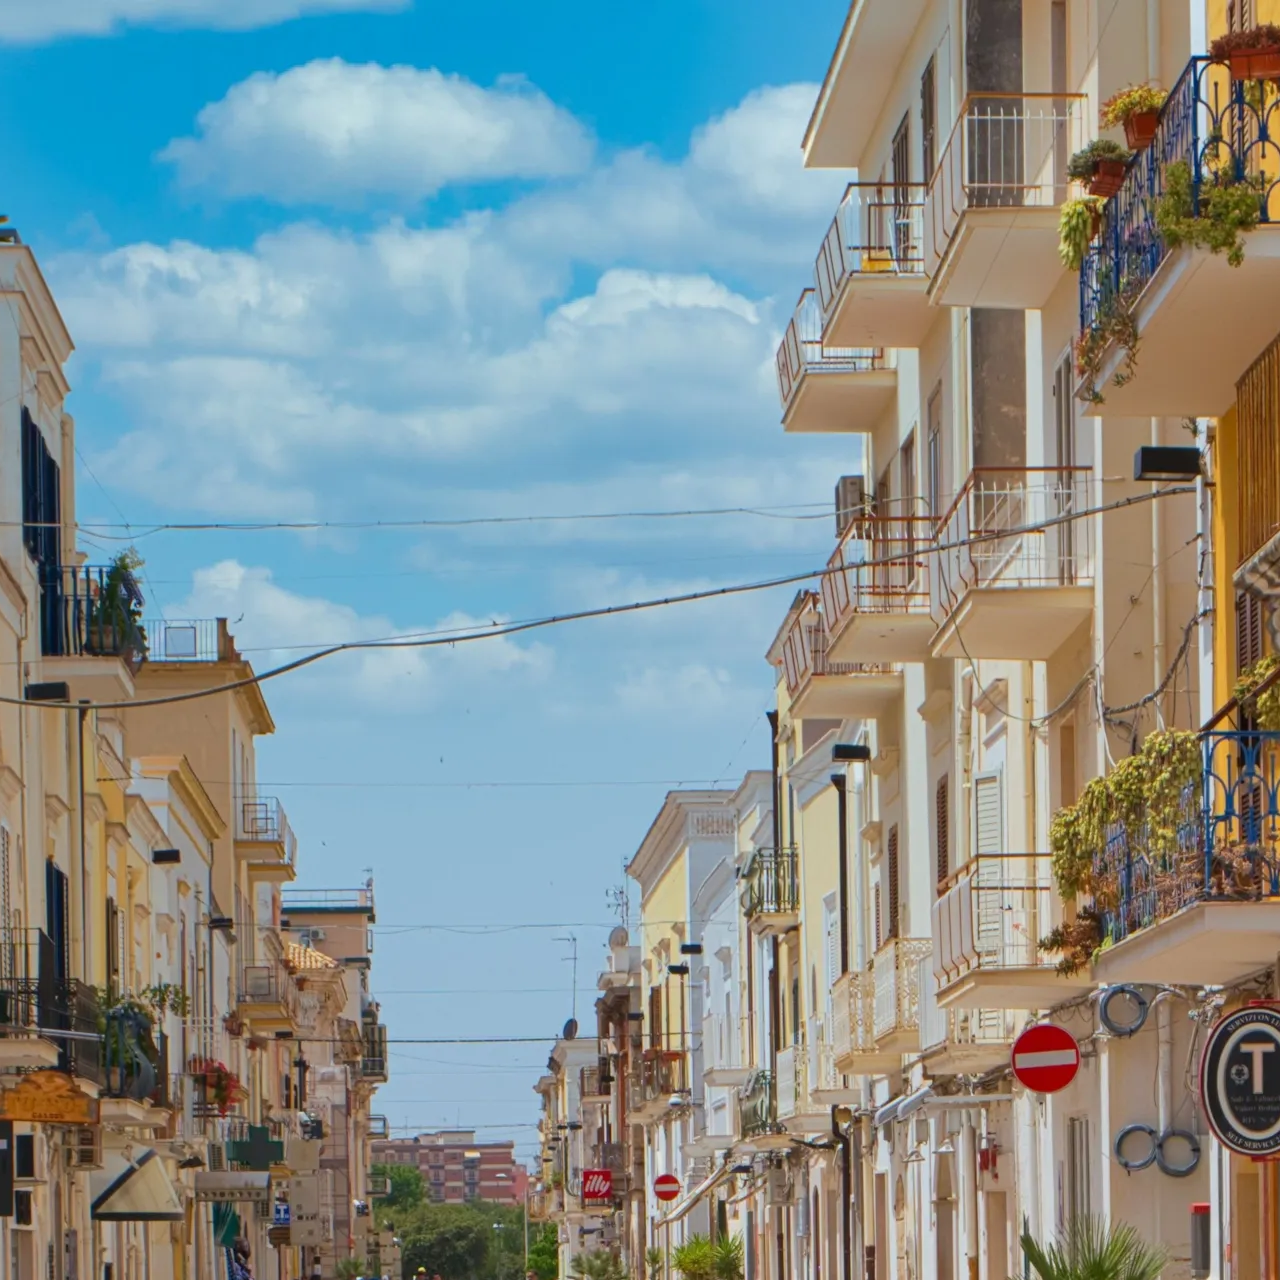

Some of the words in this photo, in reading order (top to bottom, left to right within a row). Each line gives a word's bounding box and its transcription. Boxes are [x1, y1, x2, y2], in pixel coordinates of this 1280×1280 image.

[1227, 1014, 1257, 1031] SERVIZI
[1257, 1014, 1270, 1022] ON
[1240, 1043, 1276, 1094] T
[1227, 1131, 1245, 1145] SELF
[1244, 1140, 1275, 1149] SERVICE
[585, 1174, 611, 1197] illy
